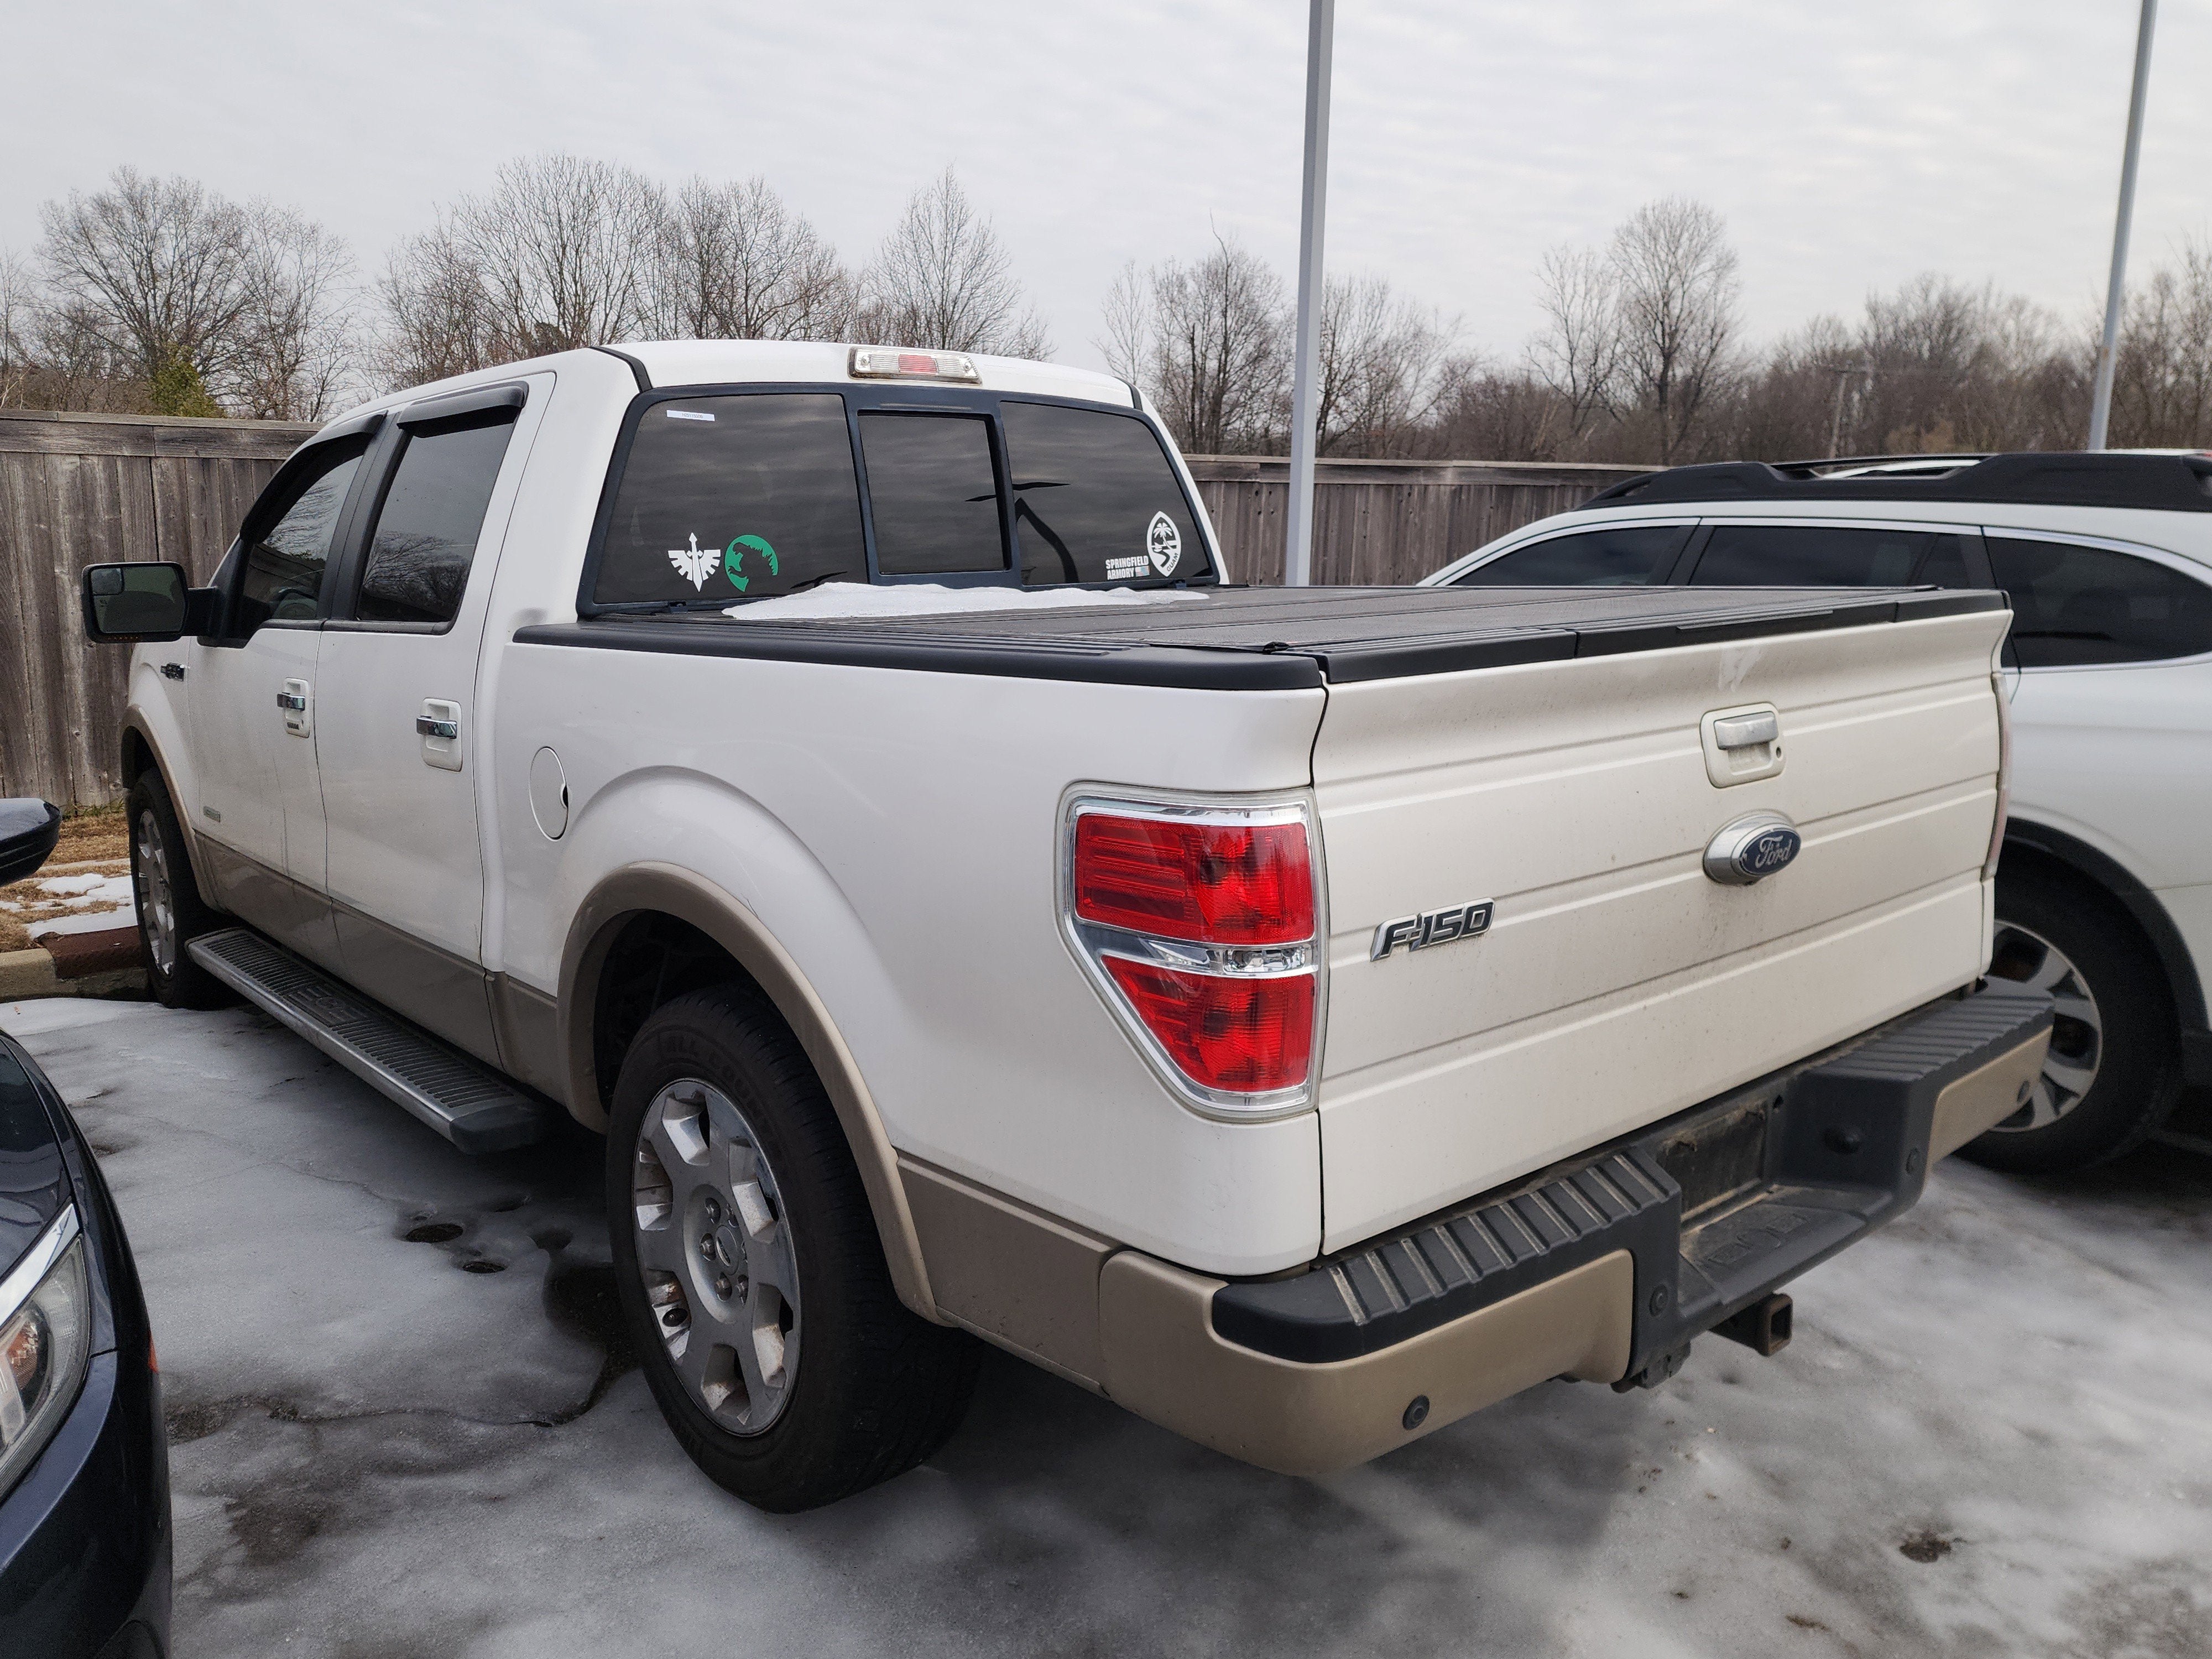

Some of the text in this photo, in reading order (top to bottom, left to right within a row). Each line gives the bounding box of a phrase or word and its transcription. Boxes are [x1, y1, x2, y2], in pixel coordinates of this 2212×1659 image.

[1105, 555, 1149, 569] SPRINGFIELD
[1167, 553, 1178, 572] GUAM
[1107, 567, 1134, 580] ARMORY
[1755, 835, 1792, 869] Ford
[1370, 897, 1495, 962] F-150
